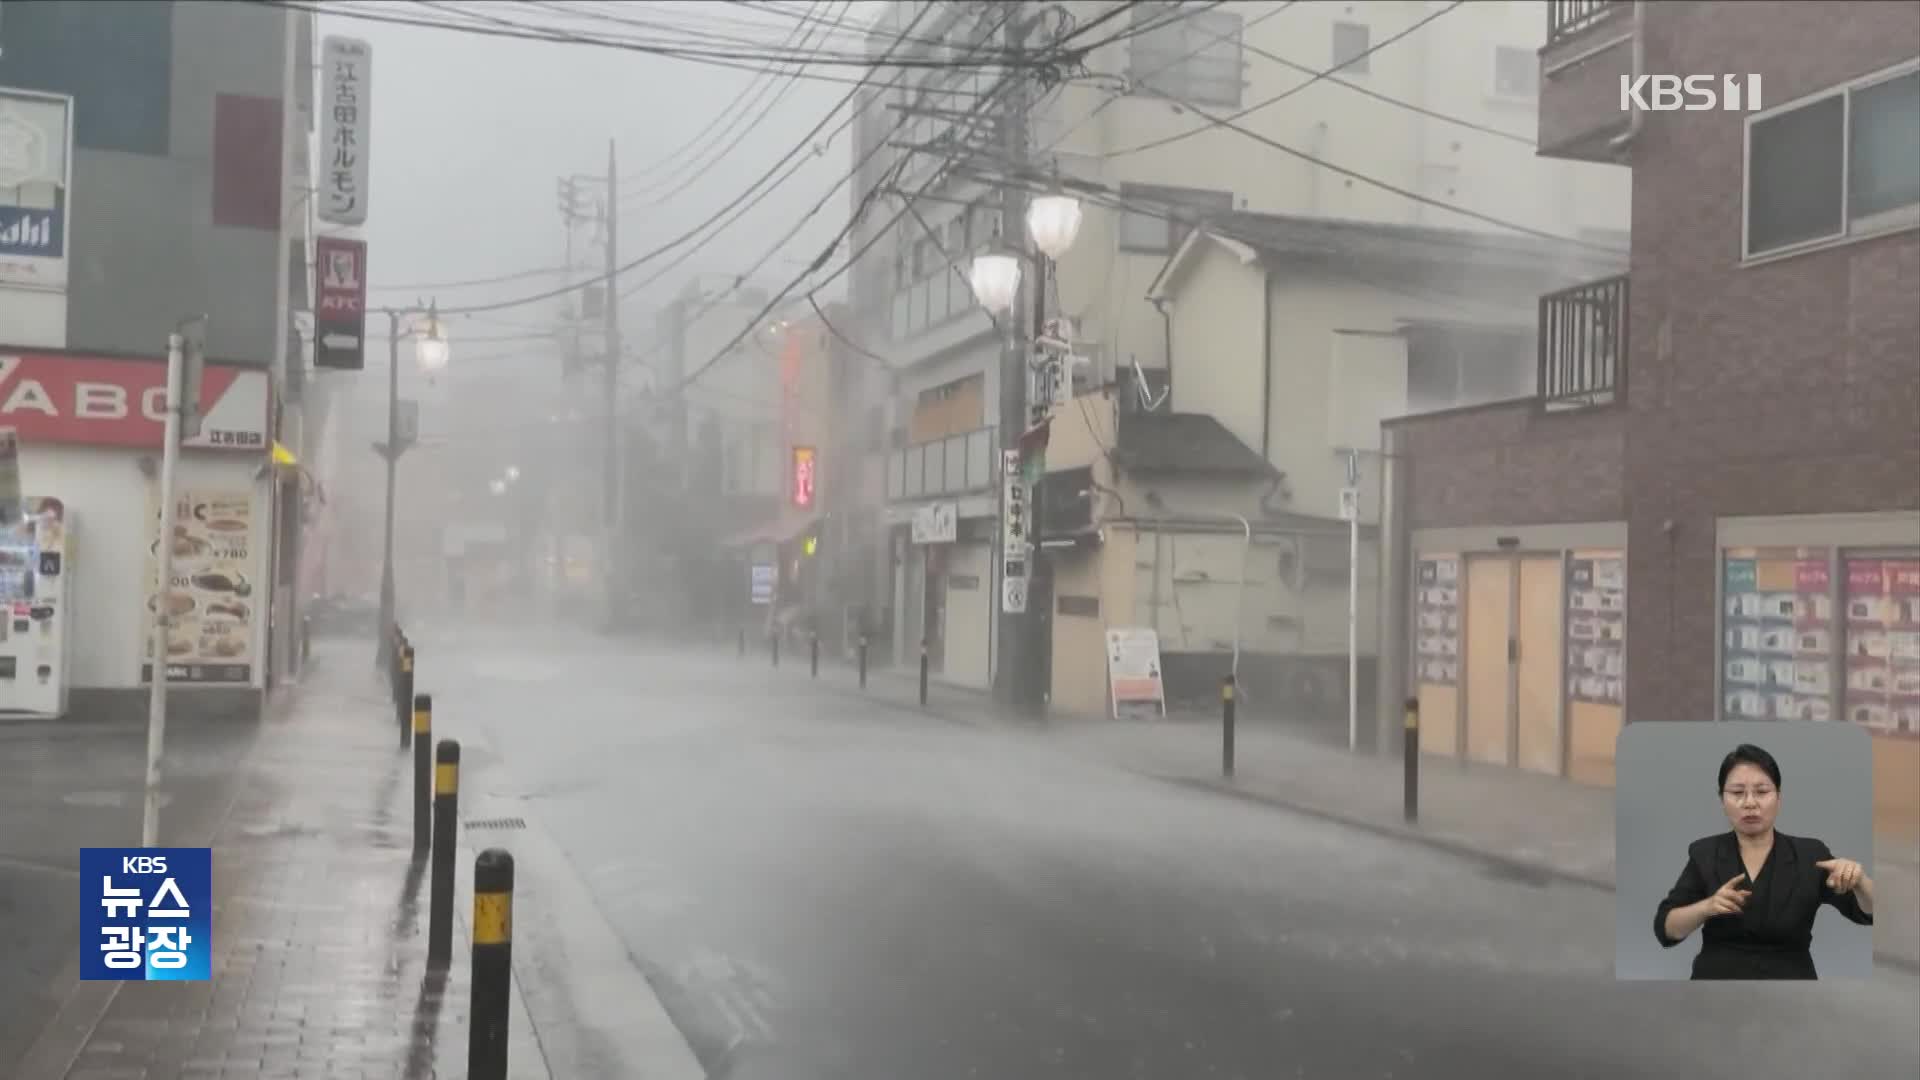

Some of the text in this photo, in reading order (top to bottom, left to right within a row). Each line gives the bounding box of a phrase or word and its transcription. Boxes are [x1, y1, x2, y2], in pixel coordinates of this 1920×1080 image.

[332, 61, 357, 213] 江古田ホルモン
[0, 213, 50, 247] ahi
[322, 297, 358, 310] KFC
